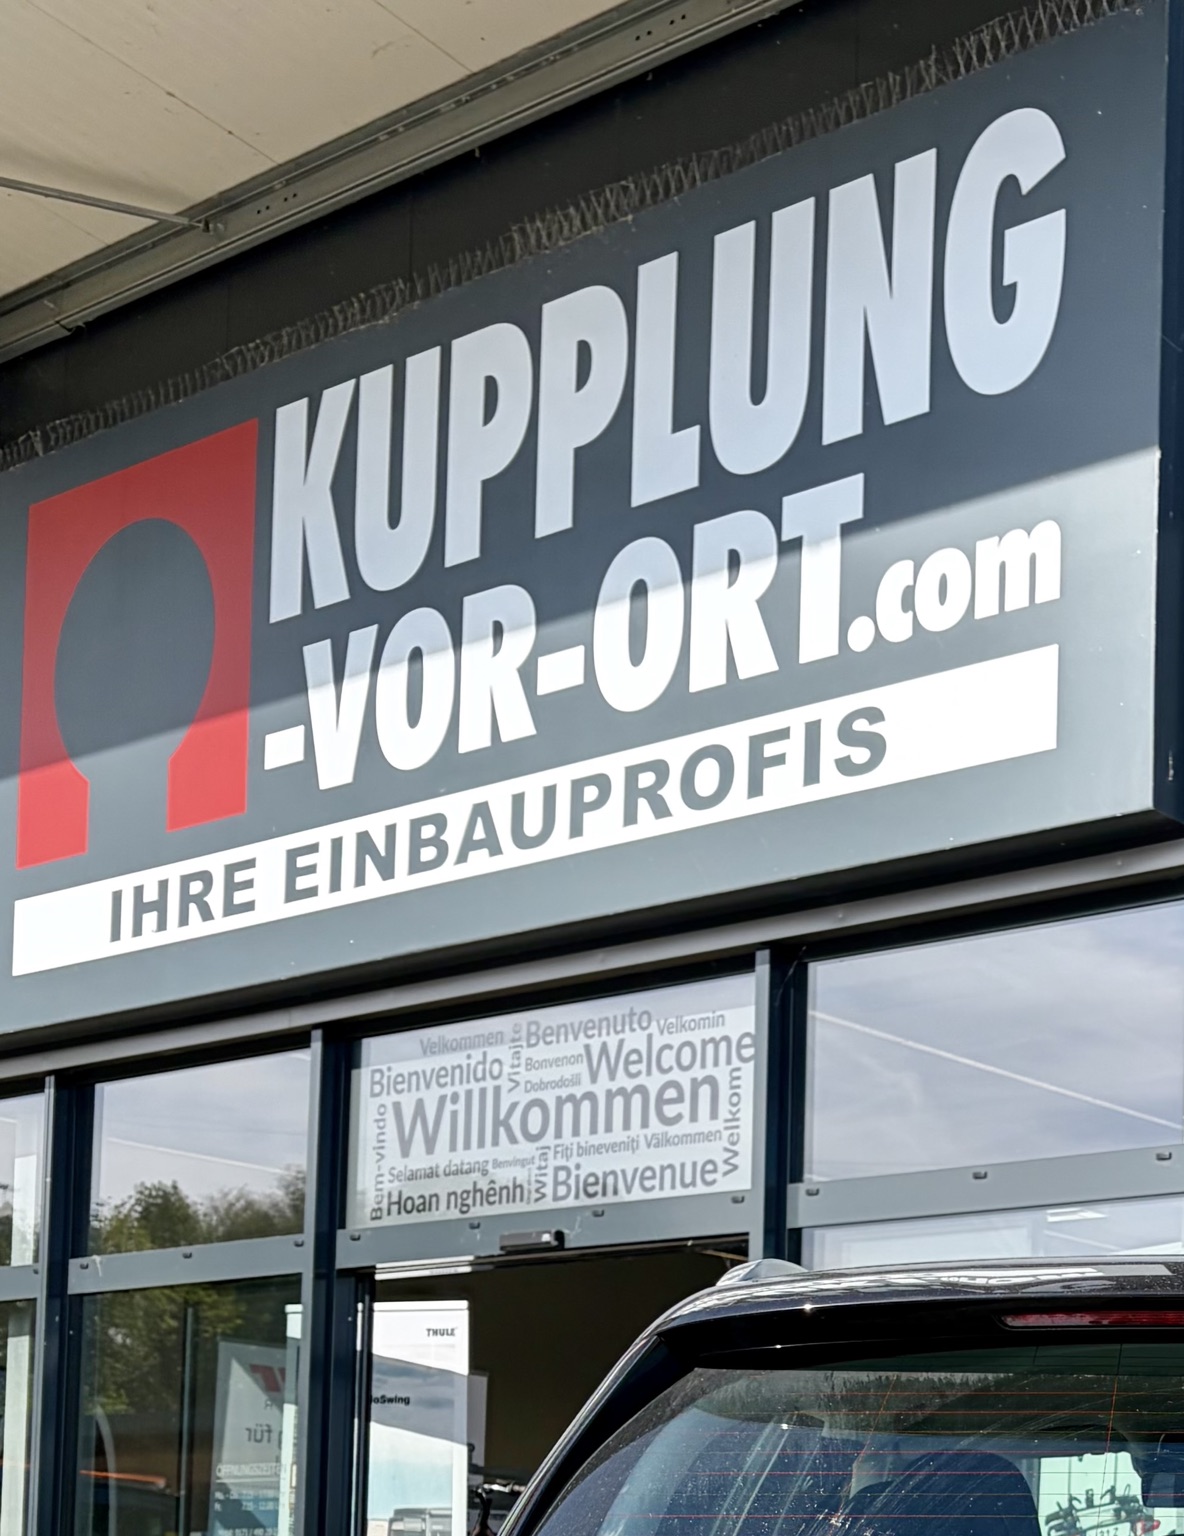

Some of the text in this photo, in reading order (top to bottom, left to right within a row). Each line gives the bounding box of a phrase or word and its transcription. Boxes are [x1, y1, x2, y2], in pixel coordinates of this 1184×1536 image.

[270, 106, 1067, 624] KUPPLUNG
[264, 473, 1062, 790] -VOR-ORT.com
[108, 705, 888, 943] IHRE EINBAUPROFIS
[419, 1030, 504, 1057] Velkommen
[526, 1007, 652, 1049] Benvenuto
[656, 1011, 725, 1036] Velkomin
[369, 1050, 504, 1098] Bienvenido
[508, 1022, 524, 1094] Vitajte
[525, 1053, 584, 1072] Bonvenon
[583, 1031, 756, 1085] Welcome
[392, 1074, 719, 1159] Willkommen
[722, 1067, 742, 1178] Welkom
[370, 1103, 387, 1221] Bem-vindo
[644, 1129, 722, 1150] Välkommen
[388, 1159, 489, 1184] Selamat datang
[492, 1155, 536, 1171] Benvingut
[534, 1146, 552, 1204] Witaj
[552, 1158, 719, 1203] Bienvenue
[386, 1189, 440, 1217] Hoan
[447, 1176, 524, 1214] nghênh
[426, 1327, 456, 1337] THULE
[370, 1394, 411, 1406] oSwing
